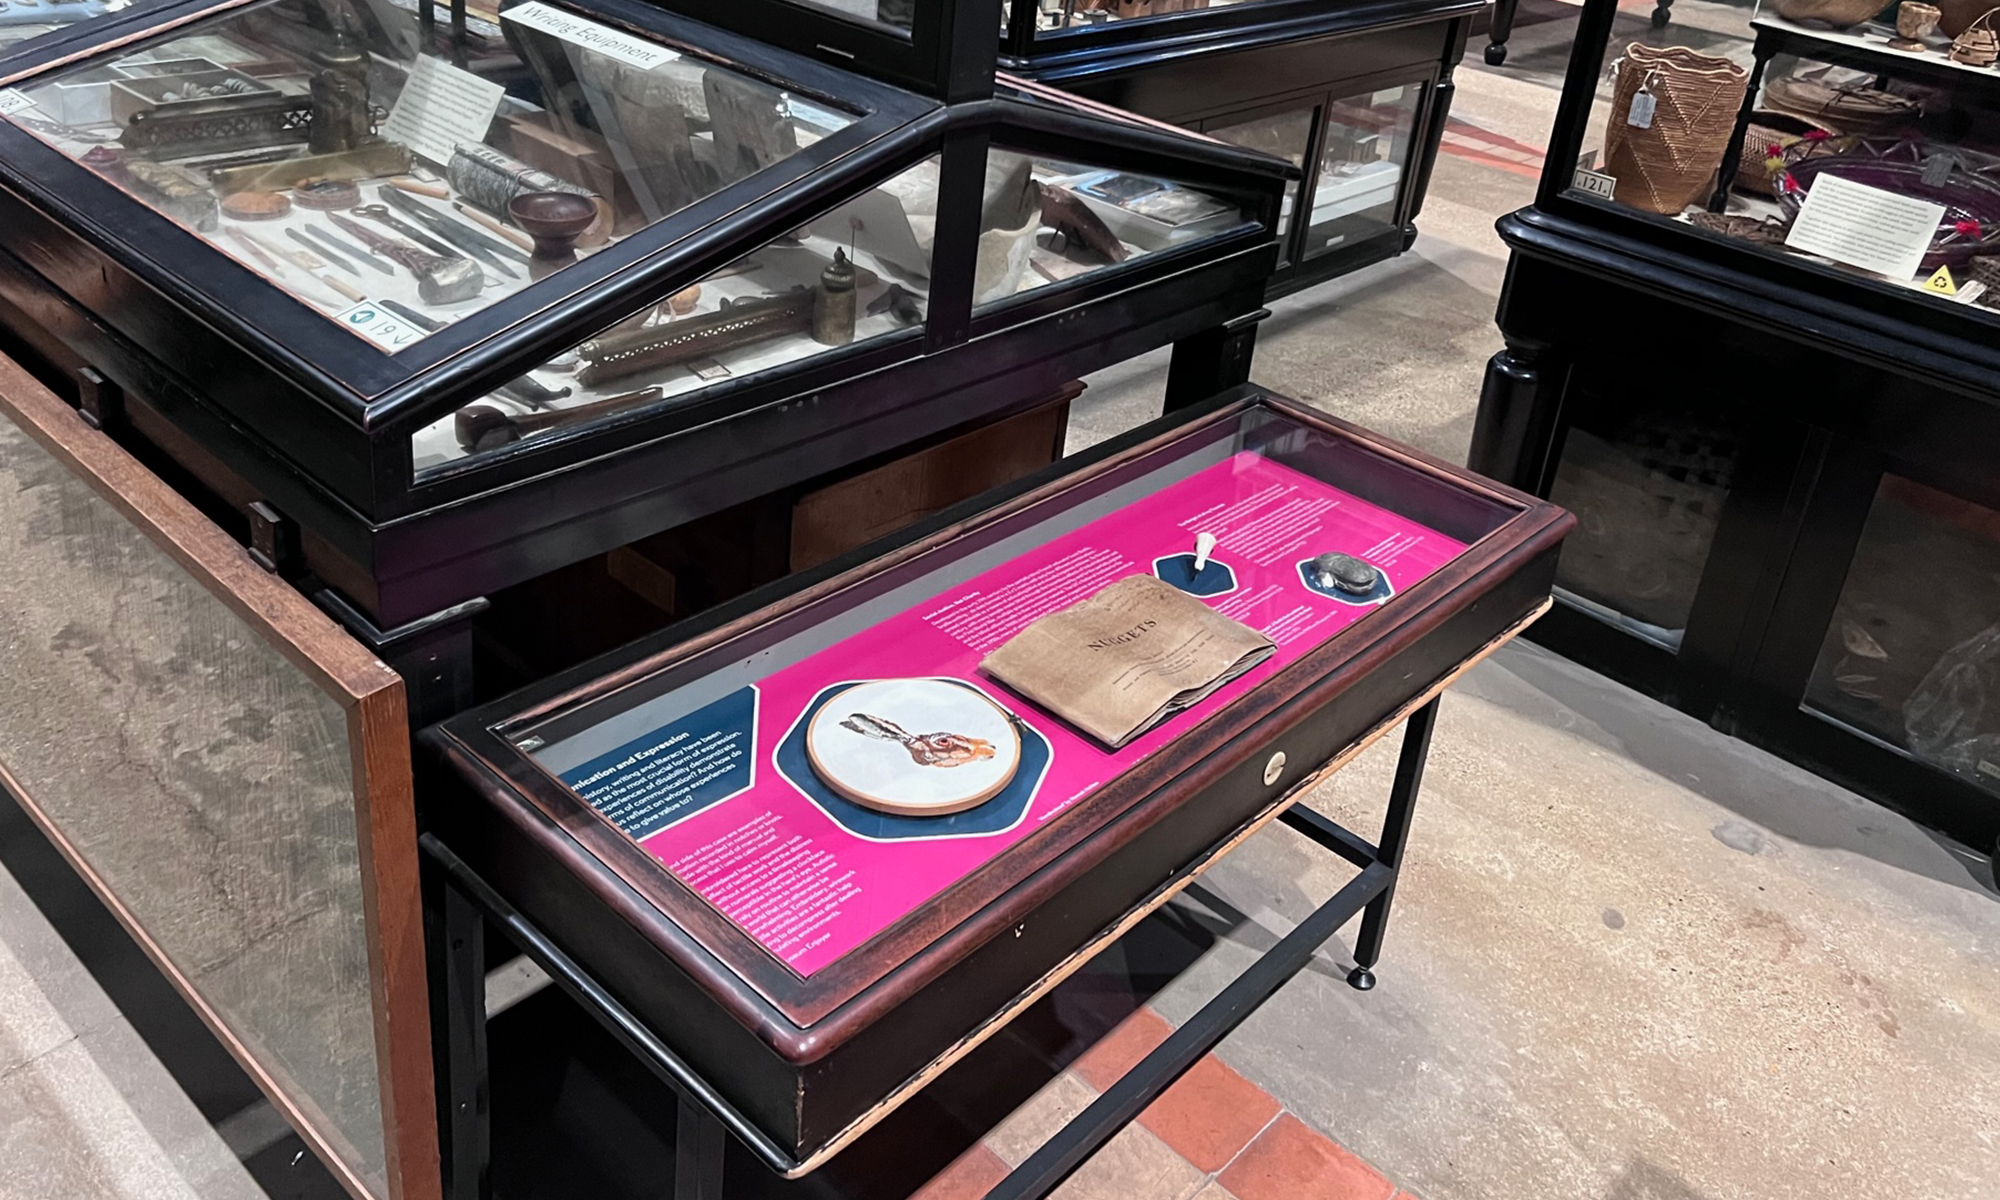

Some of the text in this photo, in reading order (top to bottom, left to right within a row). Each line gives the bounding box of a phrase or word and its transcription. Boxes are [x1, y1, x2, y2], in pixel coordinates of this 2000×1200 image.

[524, 7, 657, 62] Writing Equipment
[1087, 619, 1158, 652] NUGGETS
[612, 771, 641, 786] writing
[640, 763, 656, 773] and
[654, 750, 684, 765] literacy
[682, 741, 702, 751] have
[700, 731, 721, 743] been
[612, 788, 626, 796] the
[627, 777, 648, 789] most
[647, 764, 673, 779] crucial
[672, 756, 692, 766] form
[701, 732, 742, 753] expression.
[616, 757, 636, 769] and
[634, 733, 689, 760] Expression
[646, 782, 655, 790] of
[655, 767, 690, 785] disability
[690, 744, 736, 768] demonstrate
[624, 803, 633, 811] of
[634, 771, 697, 806] communication?
[698, 763, 715, 774] And
[713, 756, 731, 766] how
[626, 805, 653, 821] reflect
[664, 787, 690, 801] whose
[690, 764, 736, 788] experiences
[641, 814, 659, 826] give
[658, 803, 680, 816] value
[679, 795, 693, 805] to?
